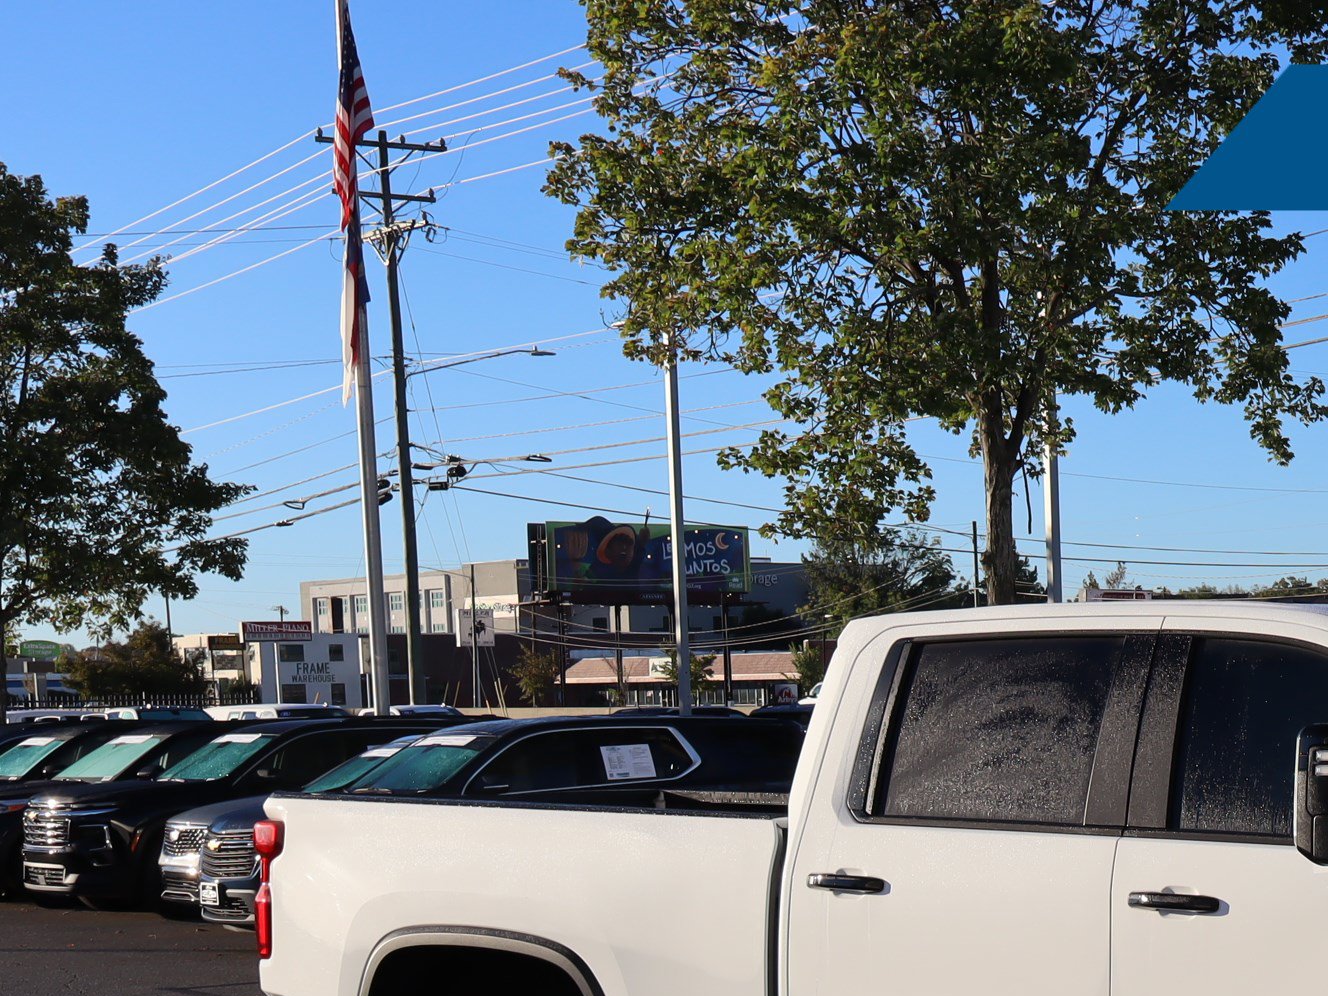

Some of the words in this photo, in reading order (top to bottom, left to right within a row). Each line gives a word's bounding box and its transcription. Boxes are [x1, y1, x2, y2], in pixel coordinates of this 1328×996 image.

[662, 541, 716, 559] LEMOS
[297, 662, 330, 674] FRAME
[292, 674, 336, 683] WAREHOUSE
